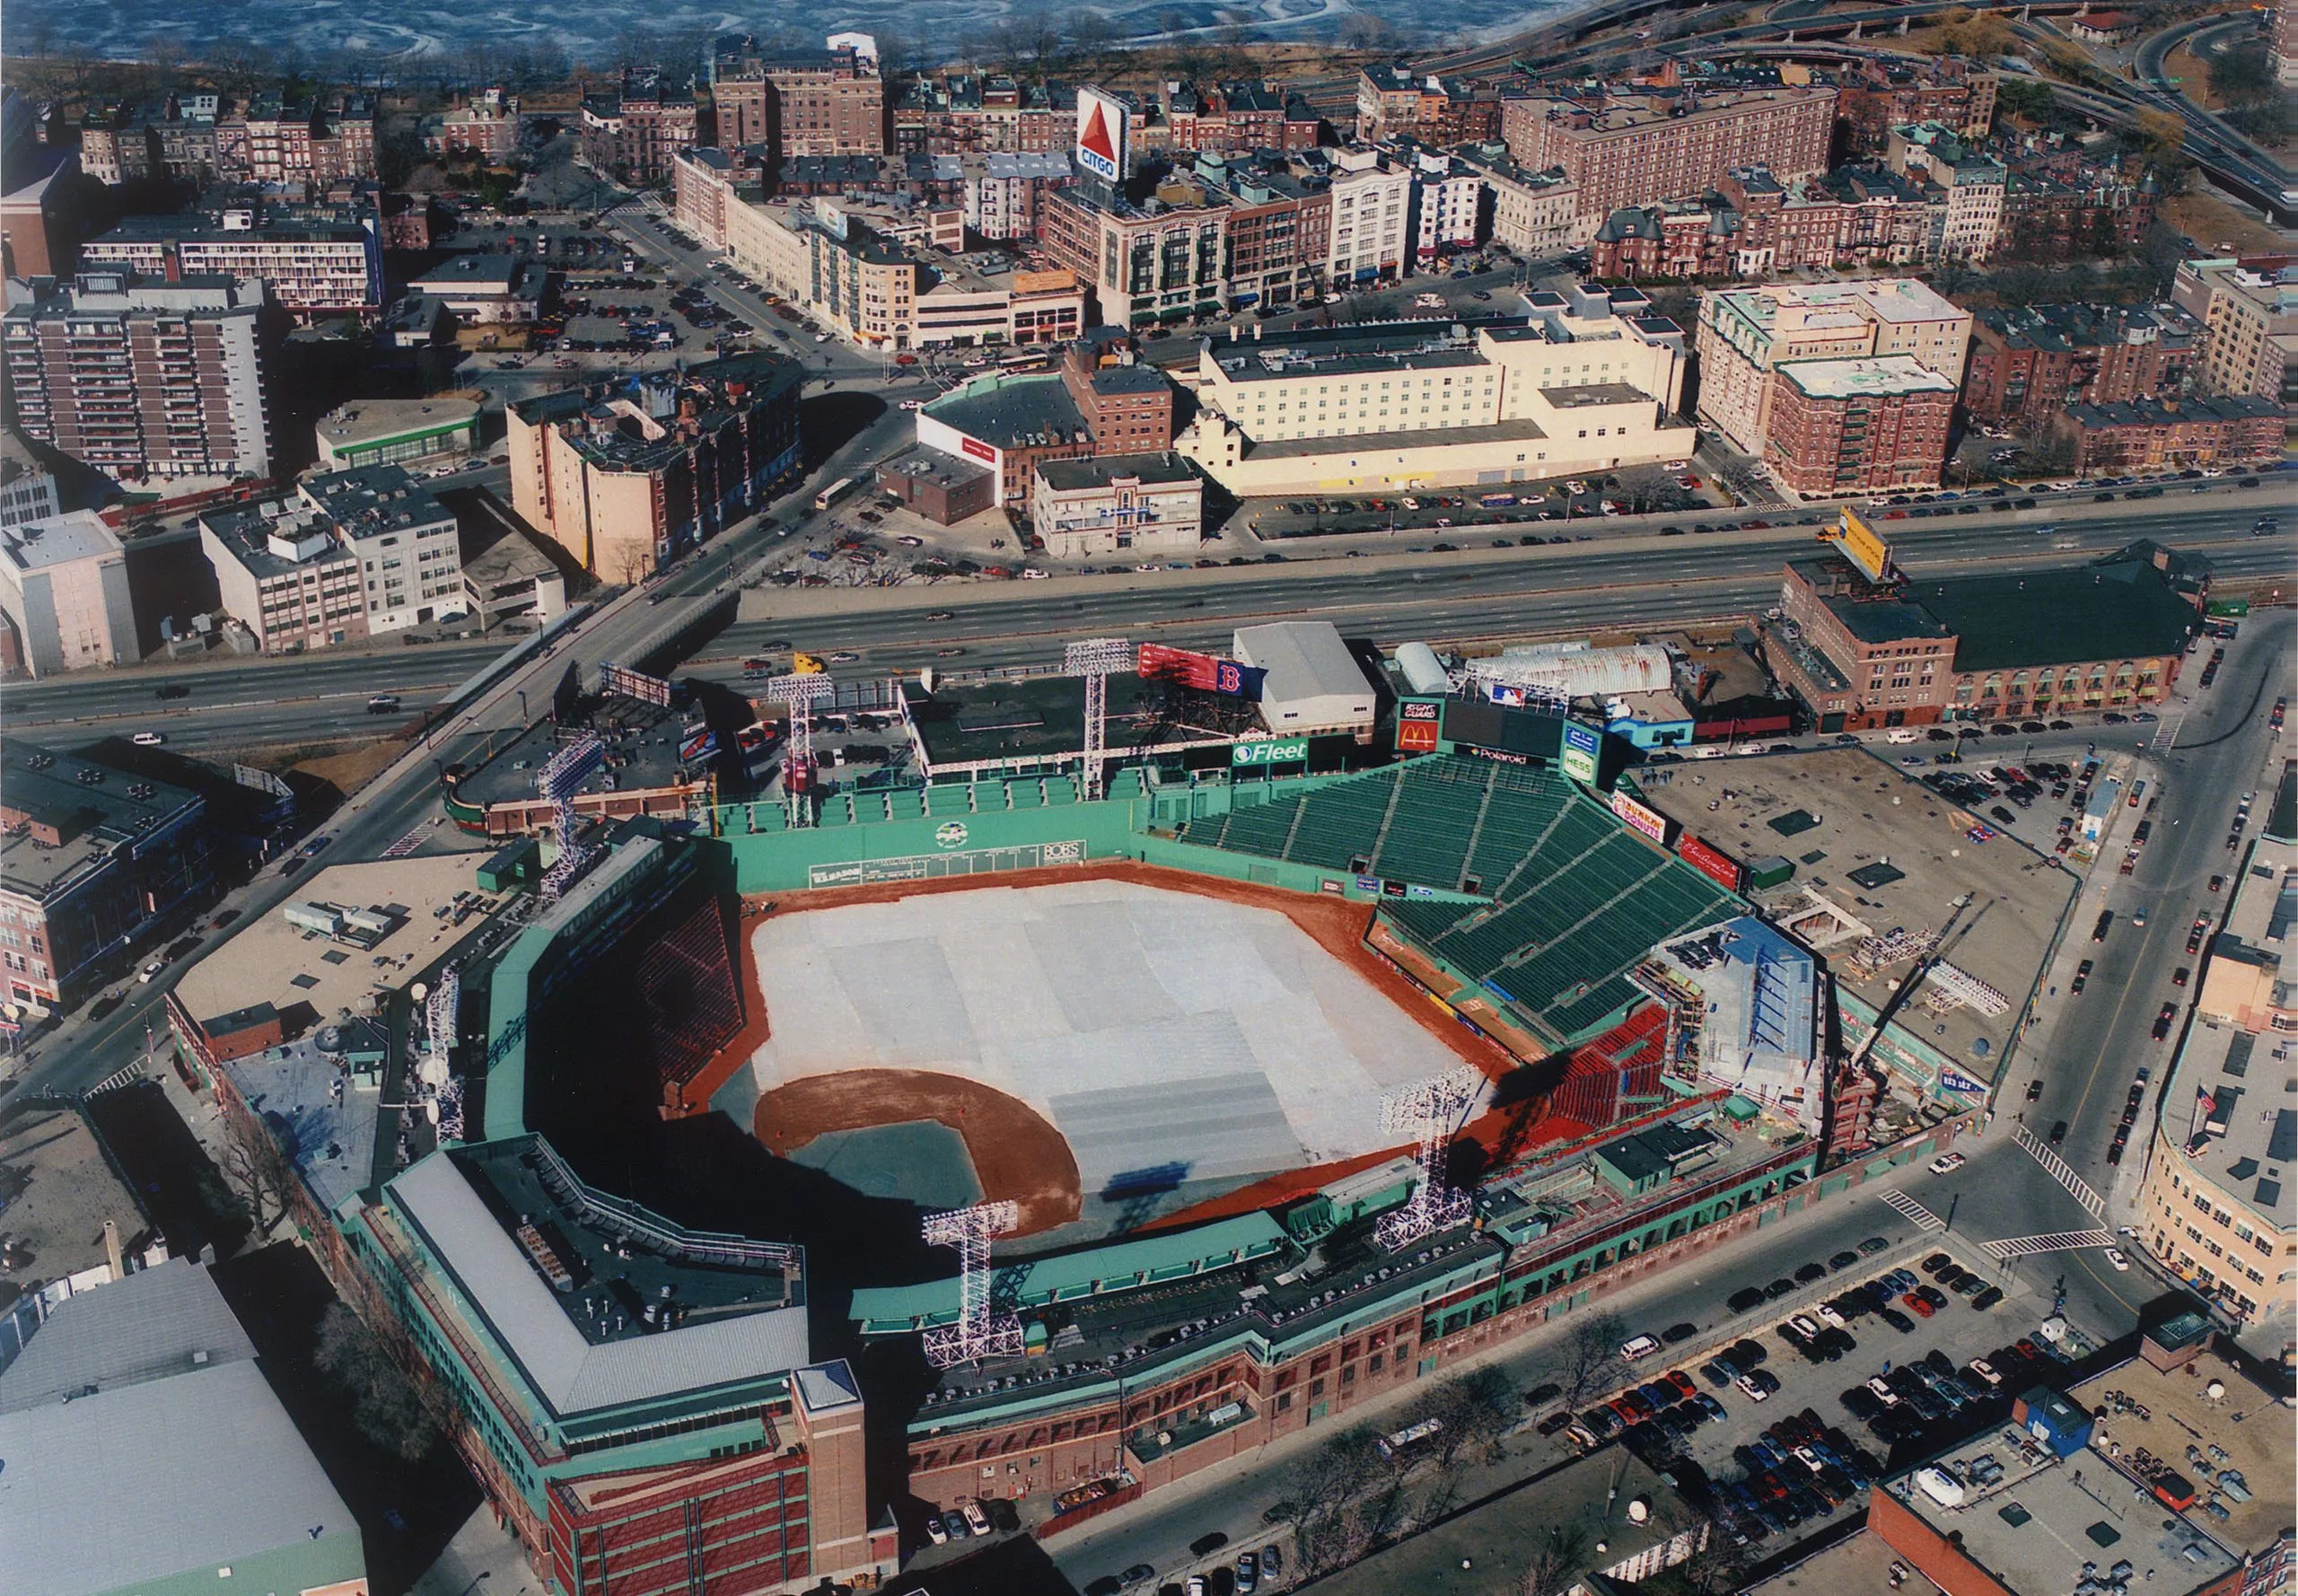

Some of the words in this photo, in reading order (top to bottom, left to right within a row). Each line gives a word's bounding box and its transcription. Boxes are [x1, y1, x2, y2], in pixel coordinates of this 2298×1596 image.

[1082, 149, 1114, 176] CITGO
[1219, 664, 1241, 692] B
[1404, 709, 1436, 718] GUARD
[1406, 703, 1436, 712] RIGHT
[1251, 742, 1307, 762] Fleet
[1480, 749, 1527, 765] Polaroid
[1566, 757, 1592, 774] HESS
[1625, 811, 1660, 839] DONUTS
[1682, 842, 1735, 879] Budweiser
[1943, 1075, 1958, 1087] RED
[1957, 1079, 1972, 1091] SOX
